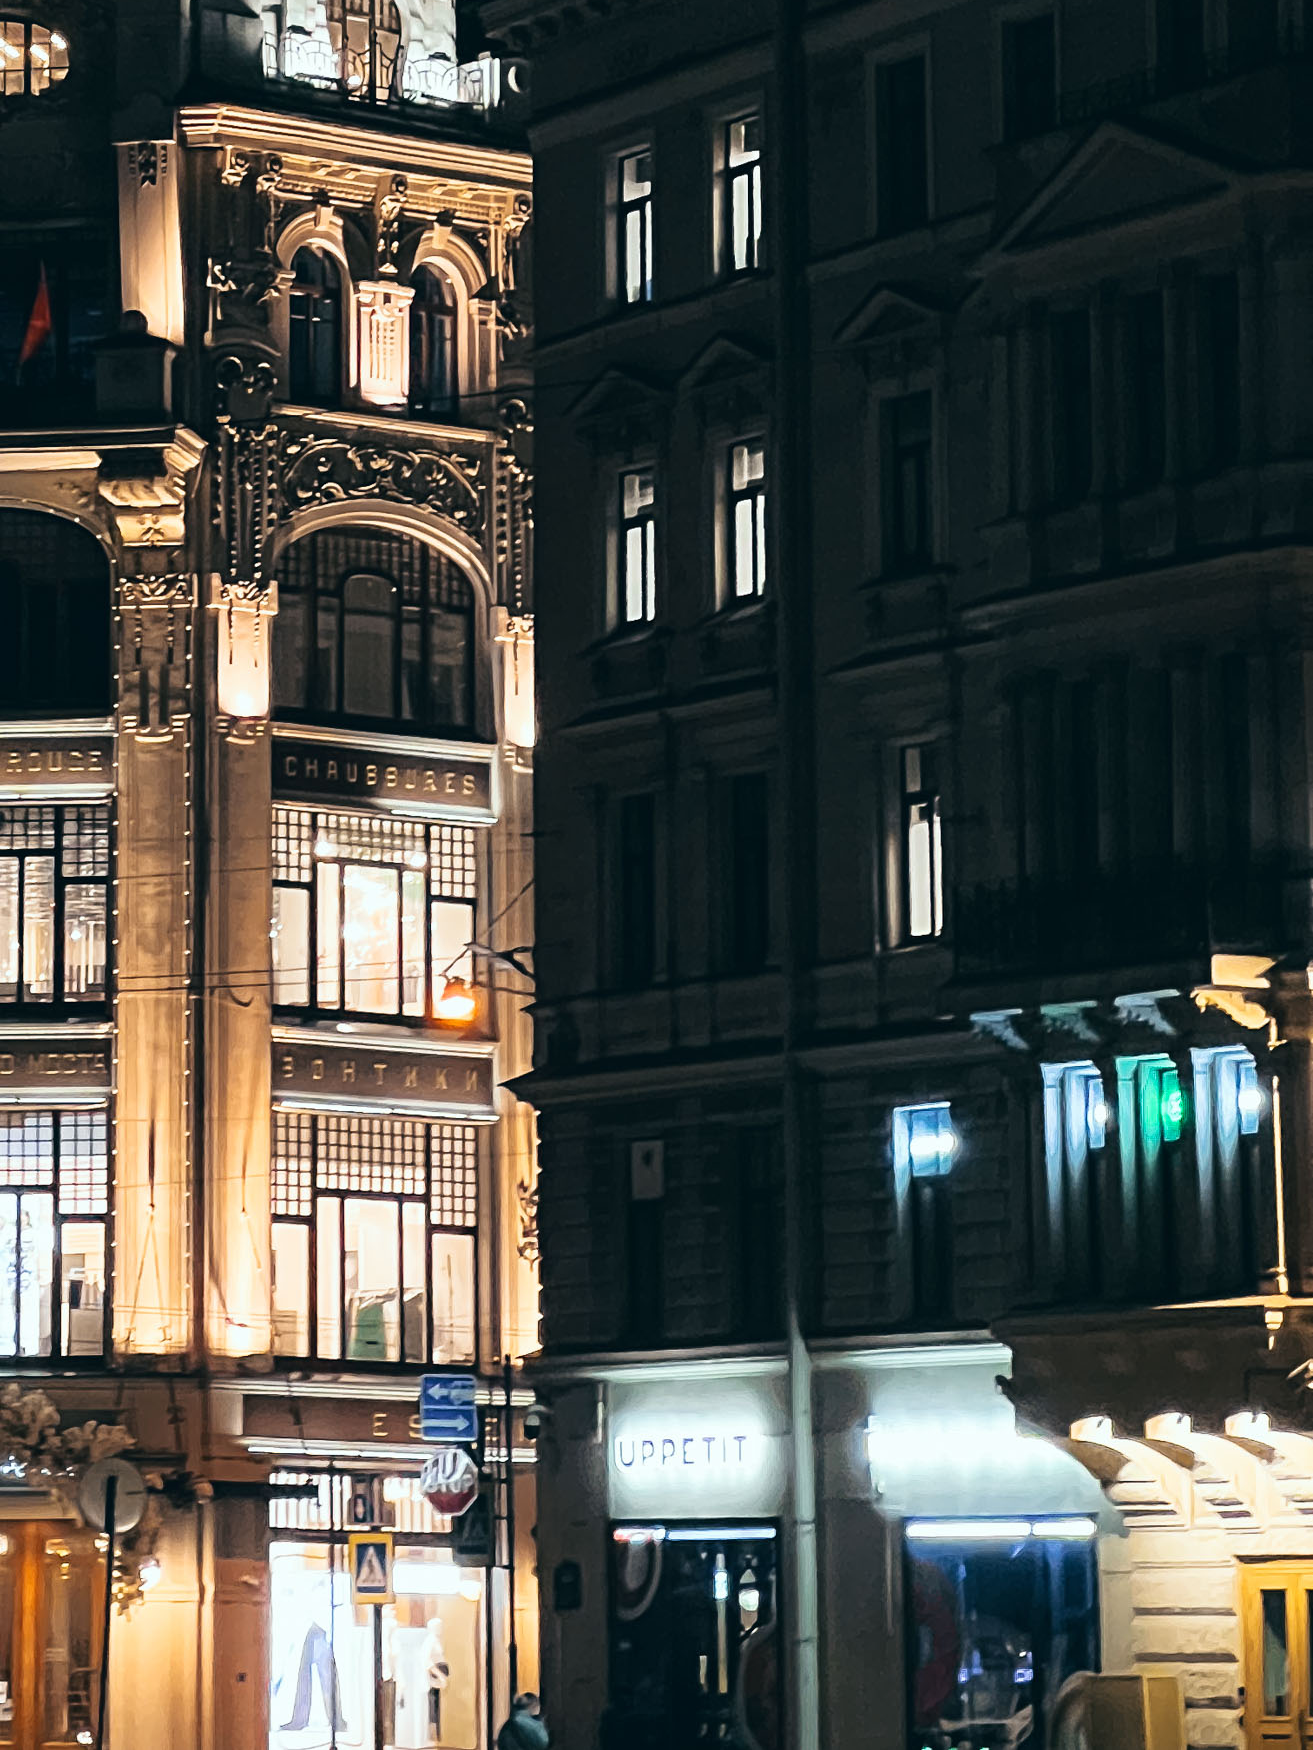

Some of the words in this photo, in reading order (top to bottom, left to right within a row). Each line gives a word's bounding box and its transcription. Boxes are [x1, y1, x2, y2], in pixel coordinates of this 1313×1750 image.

[6, 751, 103, 773] ROUGE
[284, 755, 477, 795] CHAUSSURES
[26, 1052, 108, 1075] МОСТА
[281, 1055, 479, 1092] ЗОНТИКИ
[619, 1435, 747, 1468] UPPETIT
